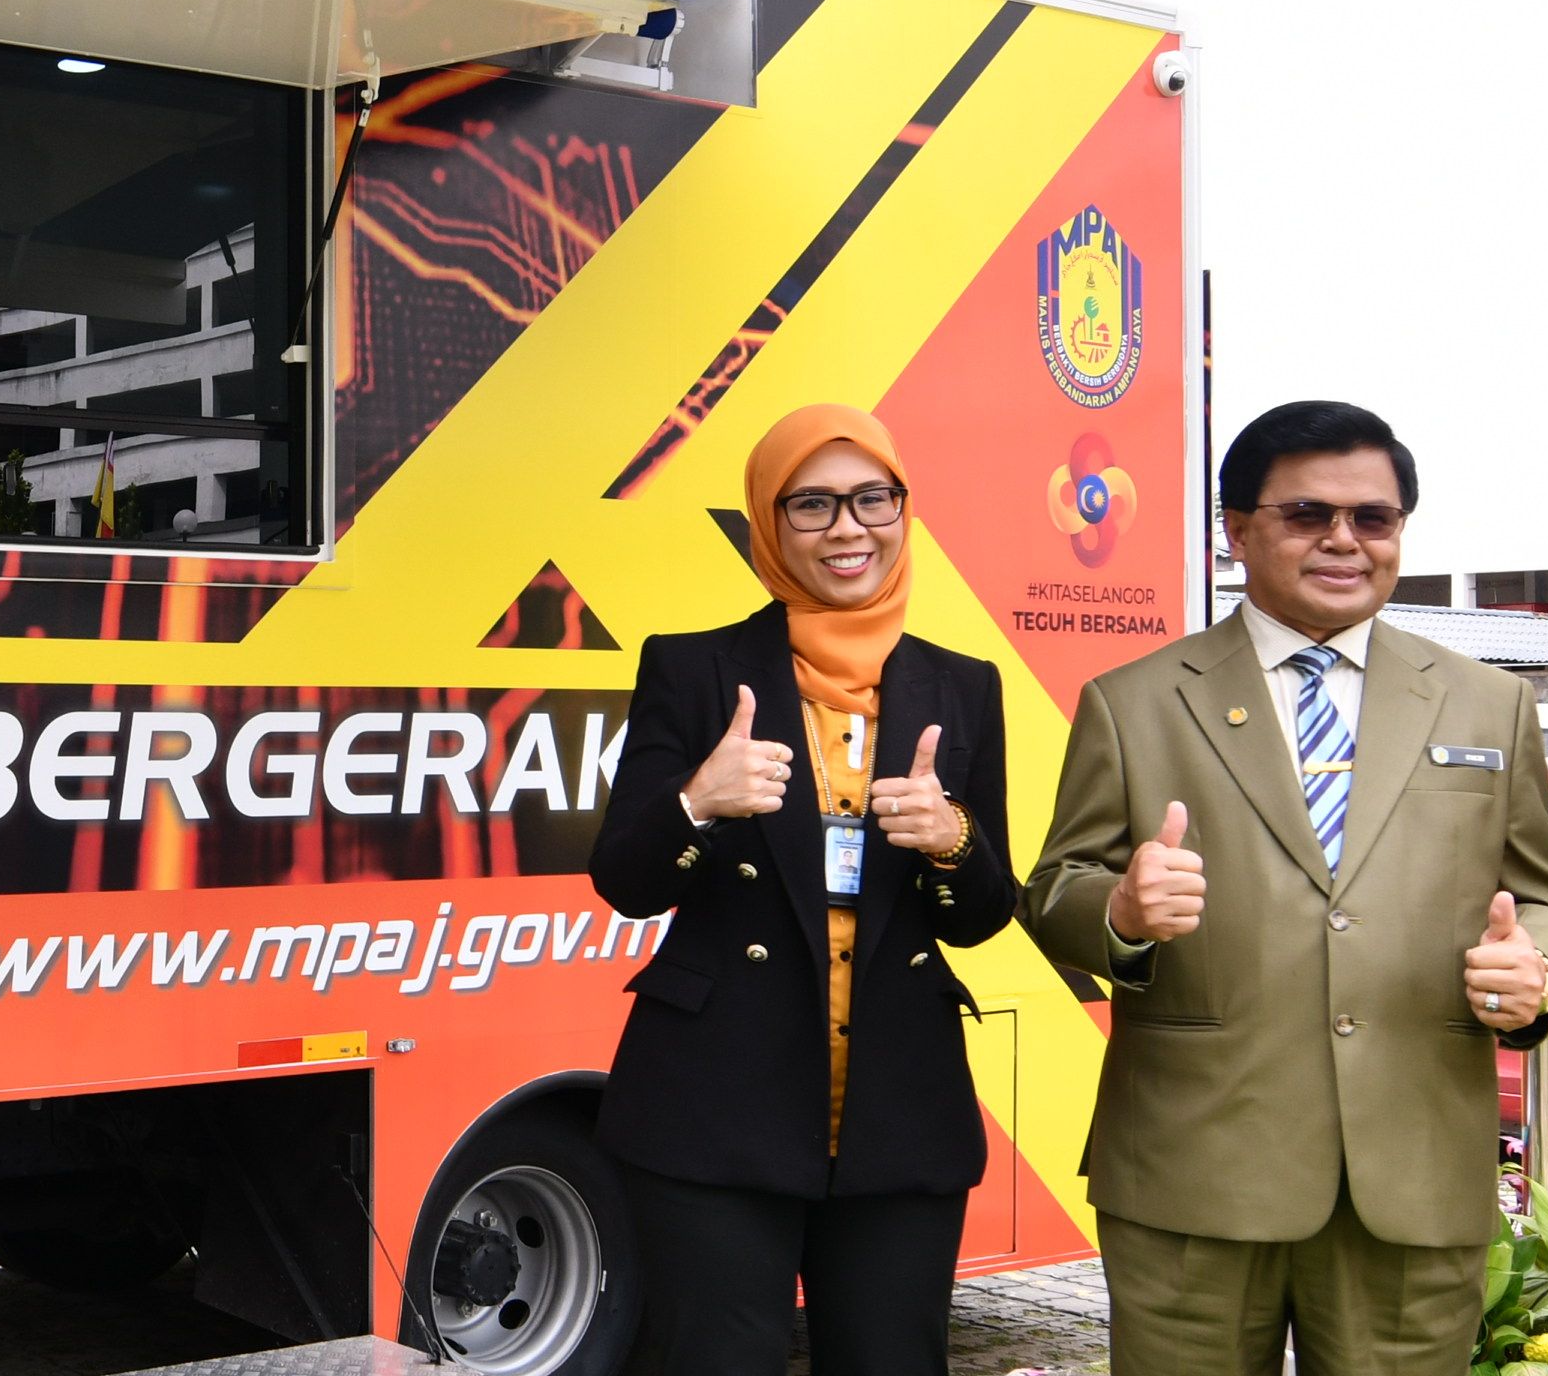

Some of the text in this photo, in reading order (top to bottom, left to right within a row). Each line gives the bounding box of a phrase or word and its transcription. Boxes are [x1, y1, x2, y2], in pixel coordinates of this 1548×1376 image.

[1038, 295, 1142, 408] MAJLIS PERBANDARAN AMPANG JAYA
[1052, 325, 1129, 387] BERBAKTI BERSIH BERBUDAYA
[1027, 582, 1156, 605] #KITASELANGOR
[1012, 611, 1168, 636] TEGUH BERSAMA
